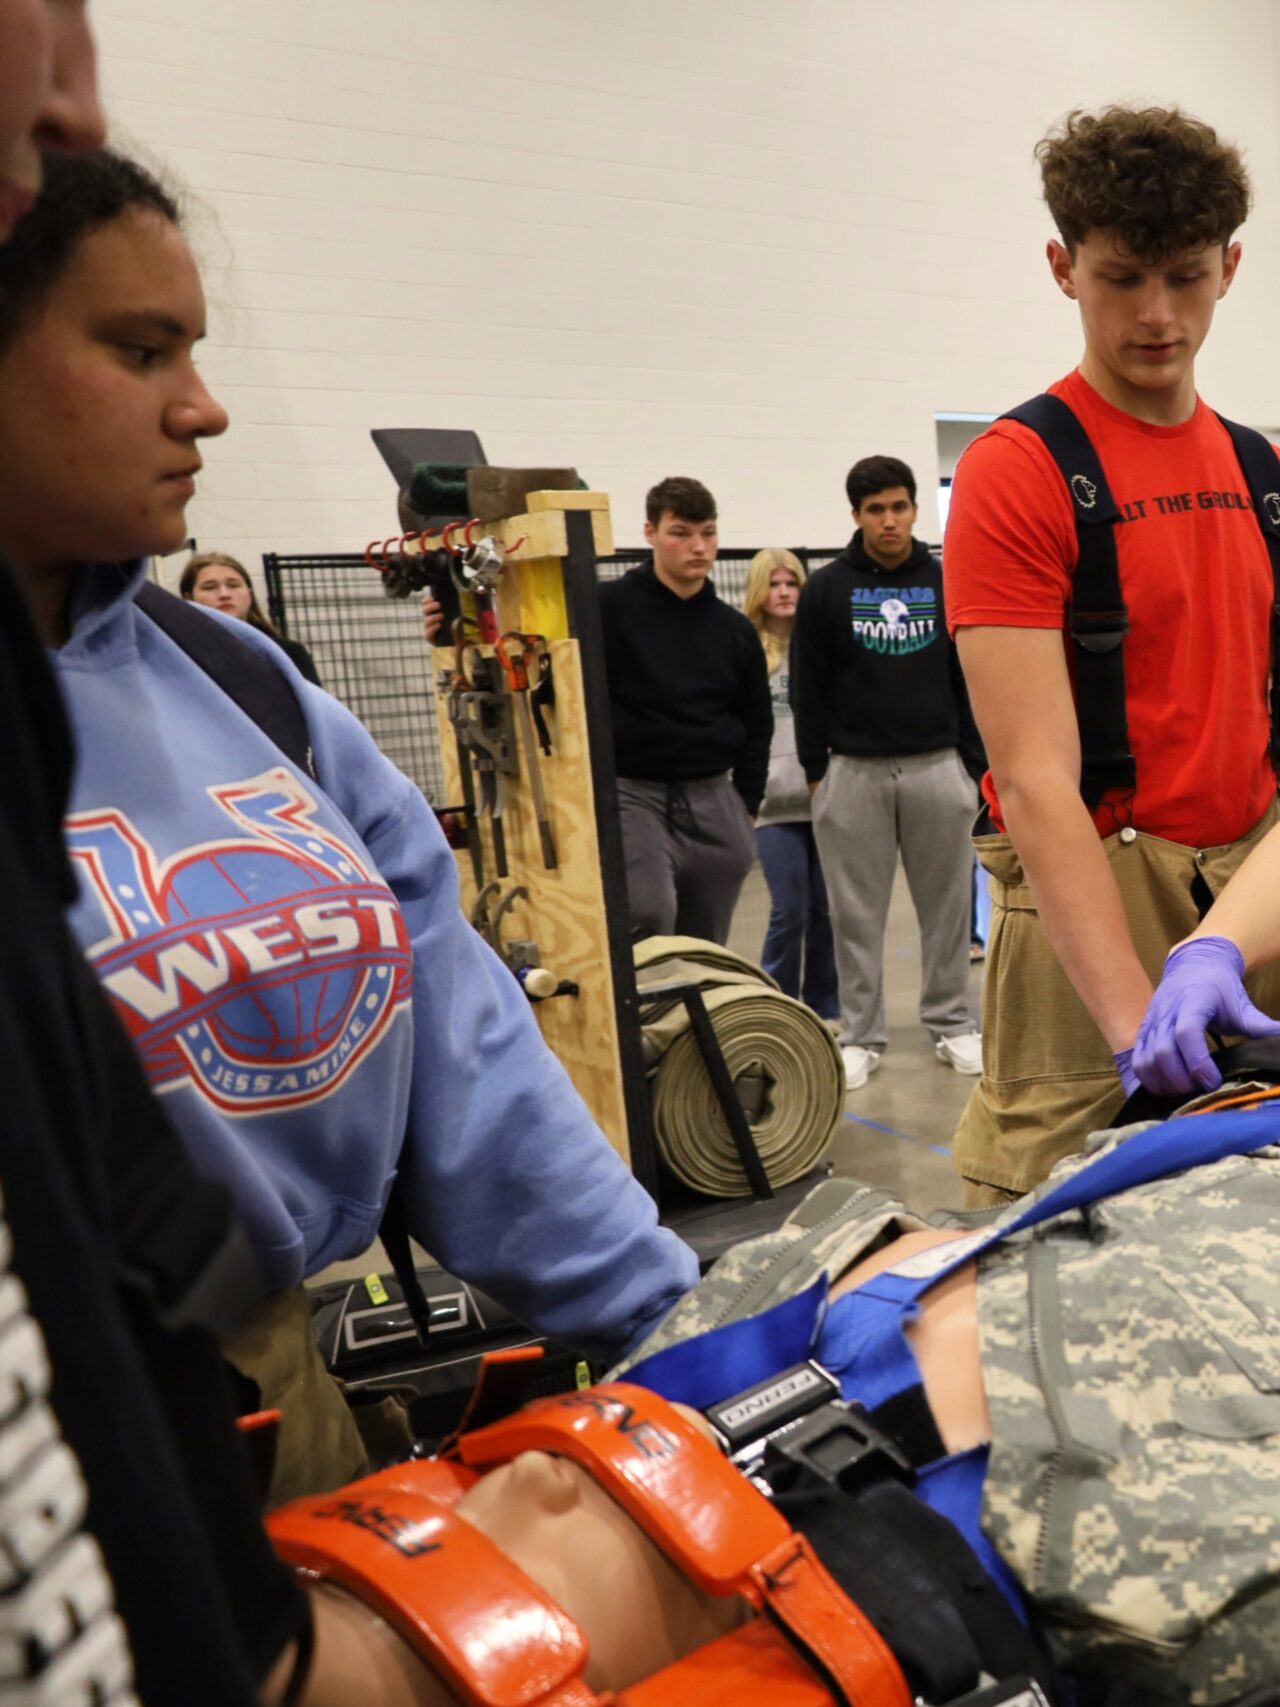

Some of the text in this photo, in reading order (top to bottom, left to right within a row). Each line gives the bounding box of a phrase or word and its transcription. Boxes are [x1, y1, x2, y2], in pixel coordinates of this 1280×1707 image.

[1152, 493, 1192, 514] THE
[852, 619, 938, 656] FOOTBALL
[102, 898, 398, 1022] WEST
[211, 1016, 366, 1092] JESSAMINE
